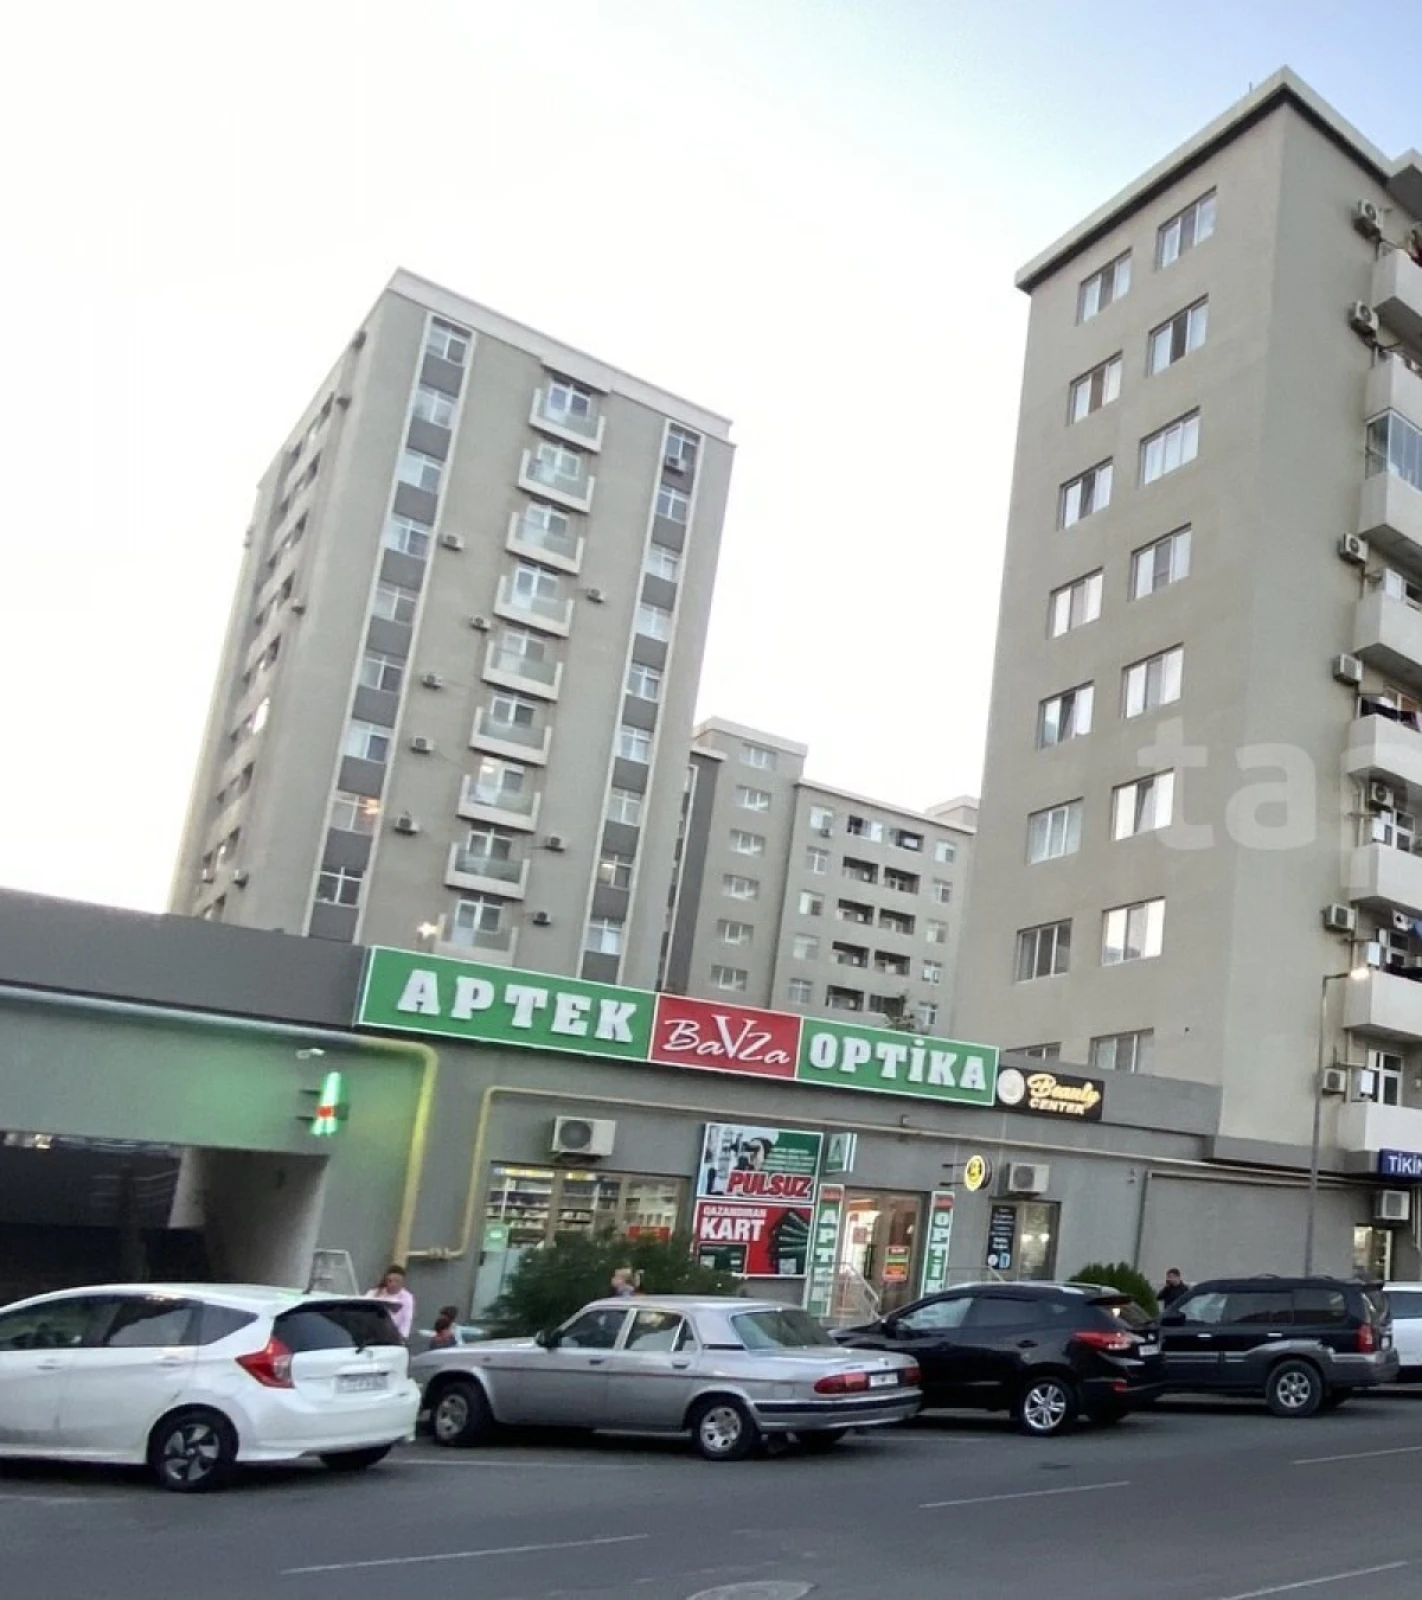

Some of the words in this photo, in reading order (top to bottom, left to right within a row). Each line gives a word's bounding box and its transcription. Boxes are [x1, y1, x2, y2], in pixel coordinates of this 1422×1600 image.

[397, 969, 637, 1043] APTEK
[809, 1033, 986, 1091] OPTİKA
[1027, 1073, 1100, 1108] Beauty
[1029, 1098, 1085, 1115] CENTER
[726, 1171, 813, 1197] PULSUZ
[701, 1216, 765, 1242] KART
